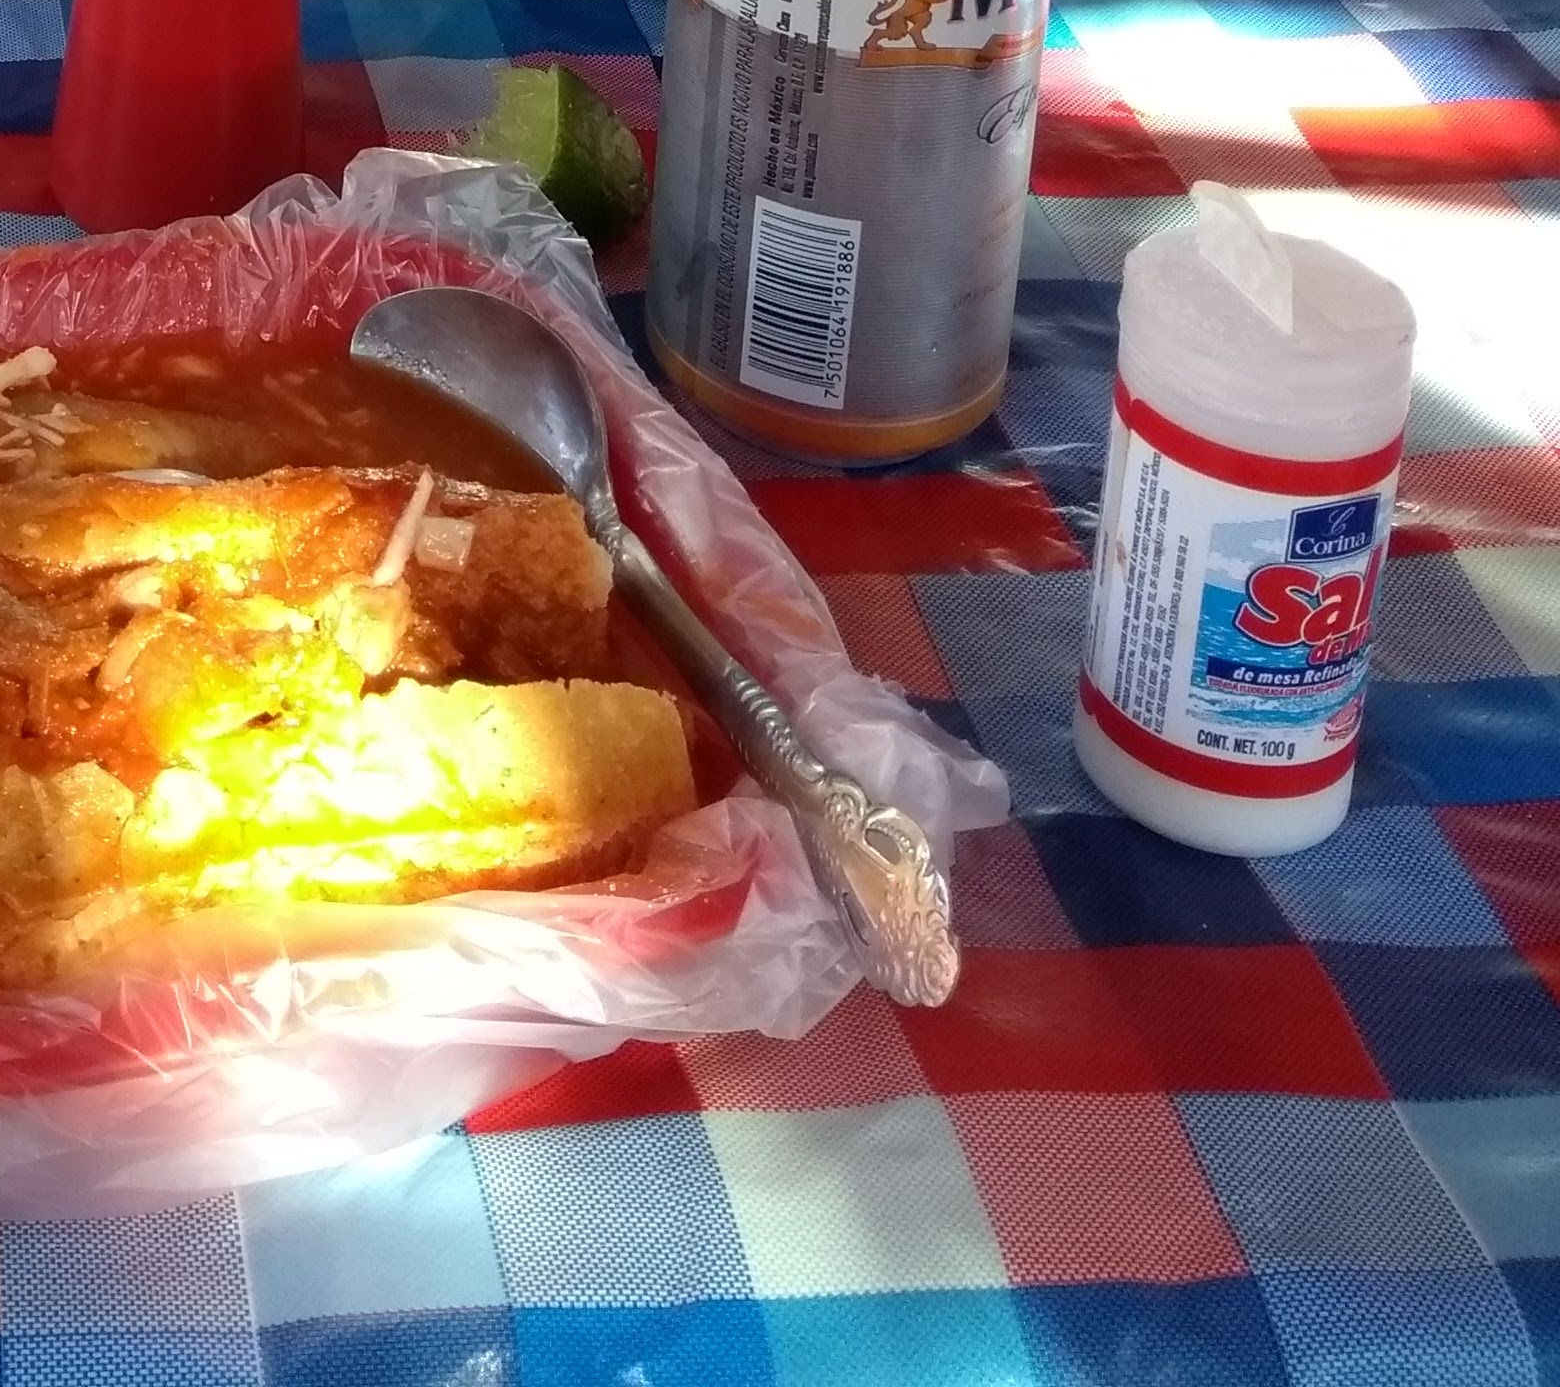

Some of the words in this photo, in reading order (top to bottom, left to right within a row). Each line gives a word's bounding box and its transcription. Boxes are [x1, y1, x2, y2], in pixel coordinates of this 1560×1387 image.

[737, 27, 756, 44] LA
[735, 47, 754, 74] PARA
[732, 72, 752, 117] NOCIVO
[767, 76, 787, 126] México
[730, 116, 749, 133] ES
[769, 128, 781, 145] en
[724, 131, 746, 192] PRODUCTO
[762, 148, 780, 188] Hecho
[722, 191, 742, 219] ESTE
[721, 216, 739, 235] DE
[716, 234, 738, 288] CONSUMO
[833, 241, 855, 307] 191886
[711, 318, 731, 355] ABUSO
[826, 316, 848, 382] 501064
[825, 389, 839, 399] 7
[1296, 531, 1366, 556] Corina
[1234, 542, 1386, 648] Sal
[1233, 665, 1254, 681] de
[1257, 672, 1300, 685] mesa
[1197, 729, 1229, 751] CONT.
[1233, 738, 1257, 755] NET.
[1261, 740, 1285, 757] 100
[1287, 741, 1296, 760] g
